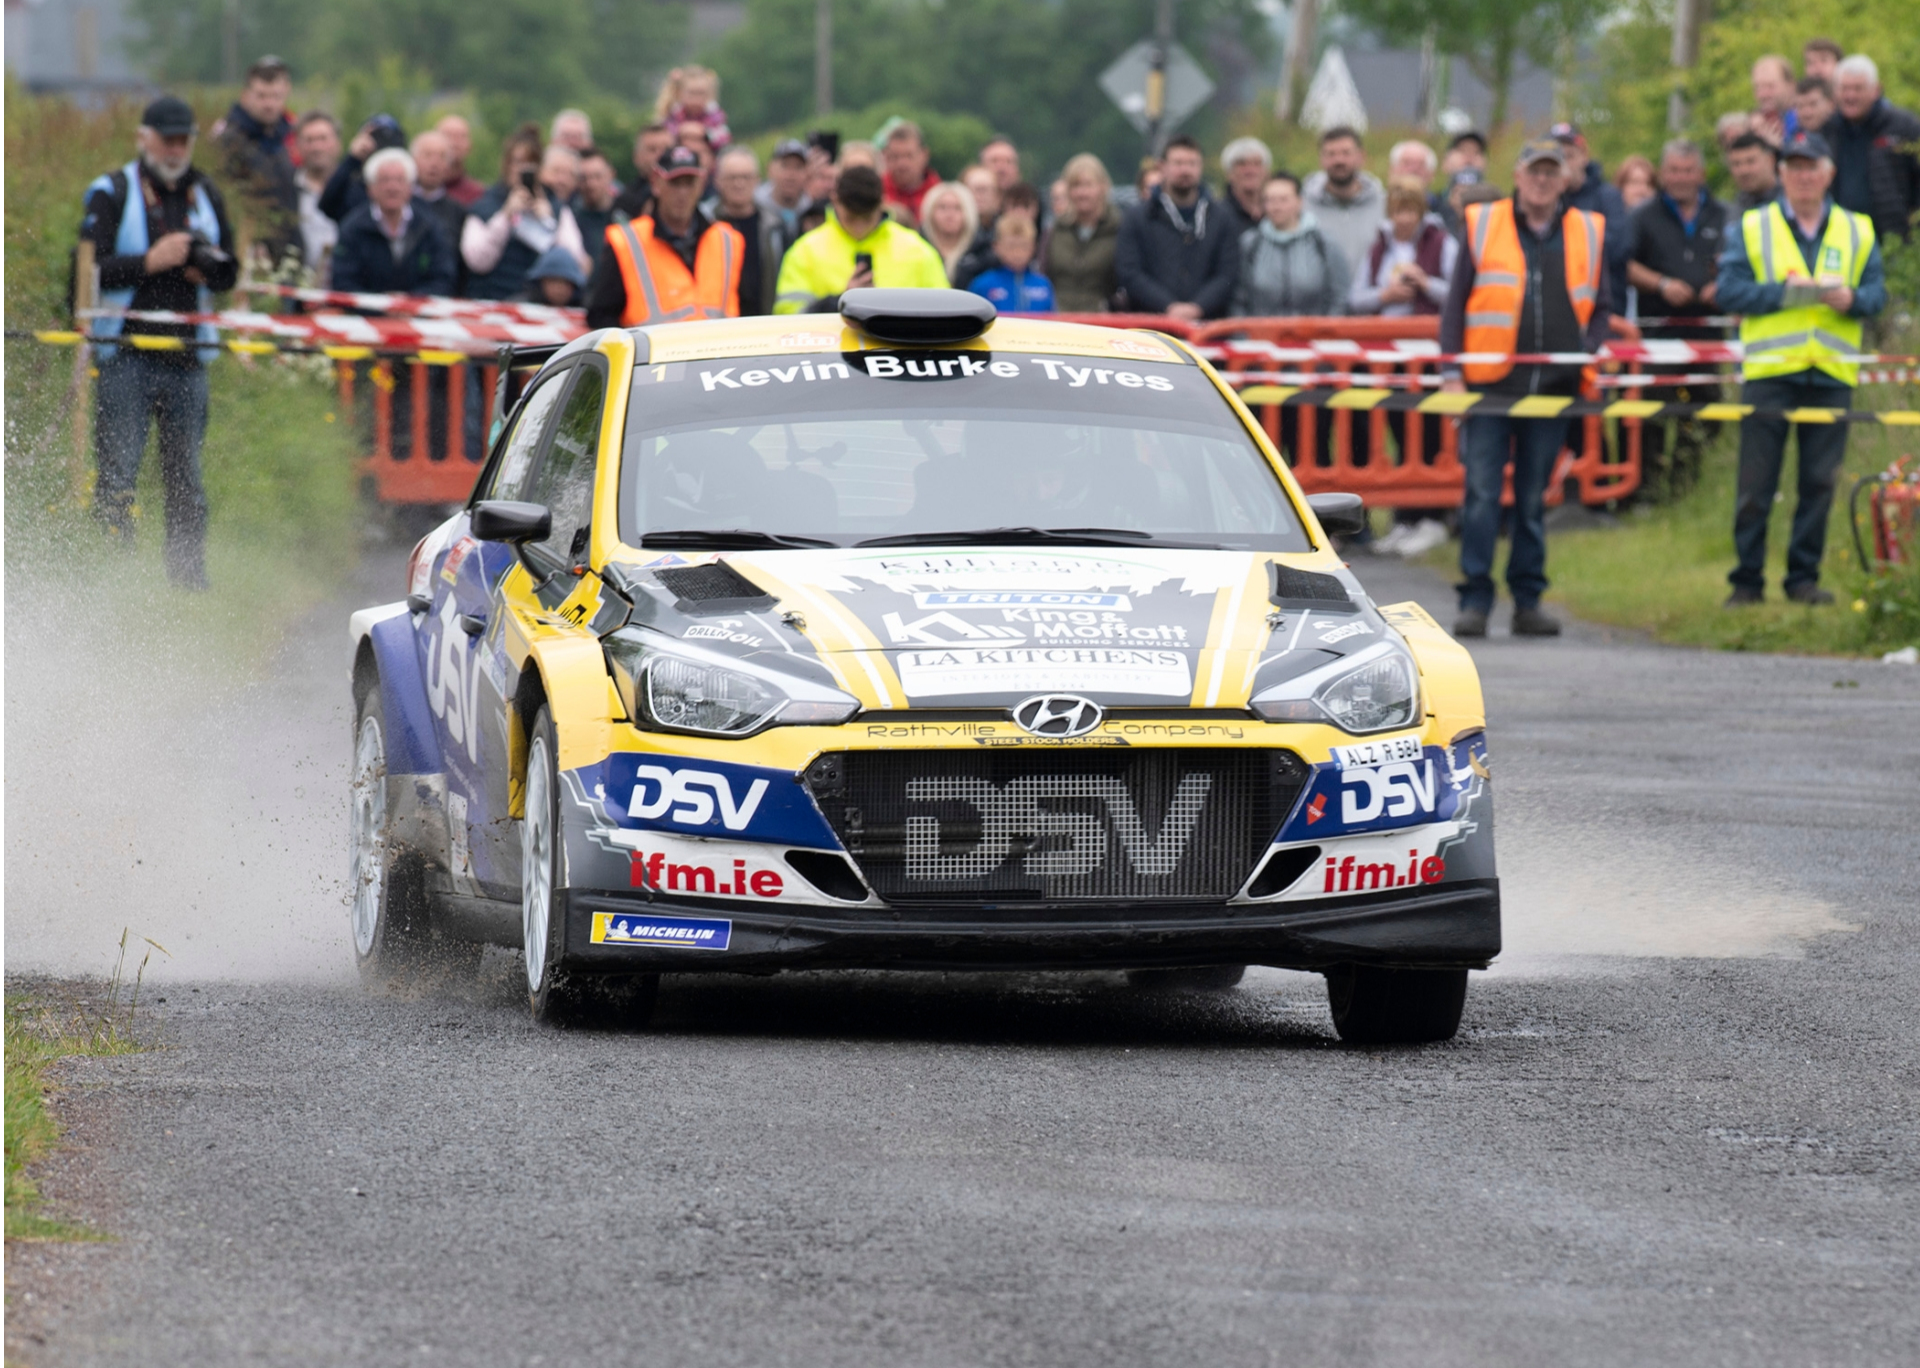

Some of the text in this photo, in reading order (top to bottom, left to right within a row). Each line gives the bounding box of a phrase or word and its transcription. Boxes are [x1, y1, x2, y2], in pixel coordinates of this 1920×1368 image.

[700, 355, 1174, 392] Kevin Burke Tyres
[943, 593, 1102, 604] TRITON
[1001, 608, 1125, 625] King &
[687, 627, 763, 647] ORLEN OIL
[1034, 623, 1187, 640] Moffatt
[912, 650, 1180, 666] LA KITCHENS
[867, 721, 1244, 738] Rathville Company
[1346, 746, 1377, 766] ALZ
[1382, 744, 1393, 760] R
[628, 765, 770, 831] DSV
[1341, 759, 1435, 824] DSV
[906, 773, 1212, 880] DSV
[630, 851, 783, 897] ifm.ie
[1323, 849, 1445, 893] ifm.ie
[632, 925, 716, 940] MICHELIN
